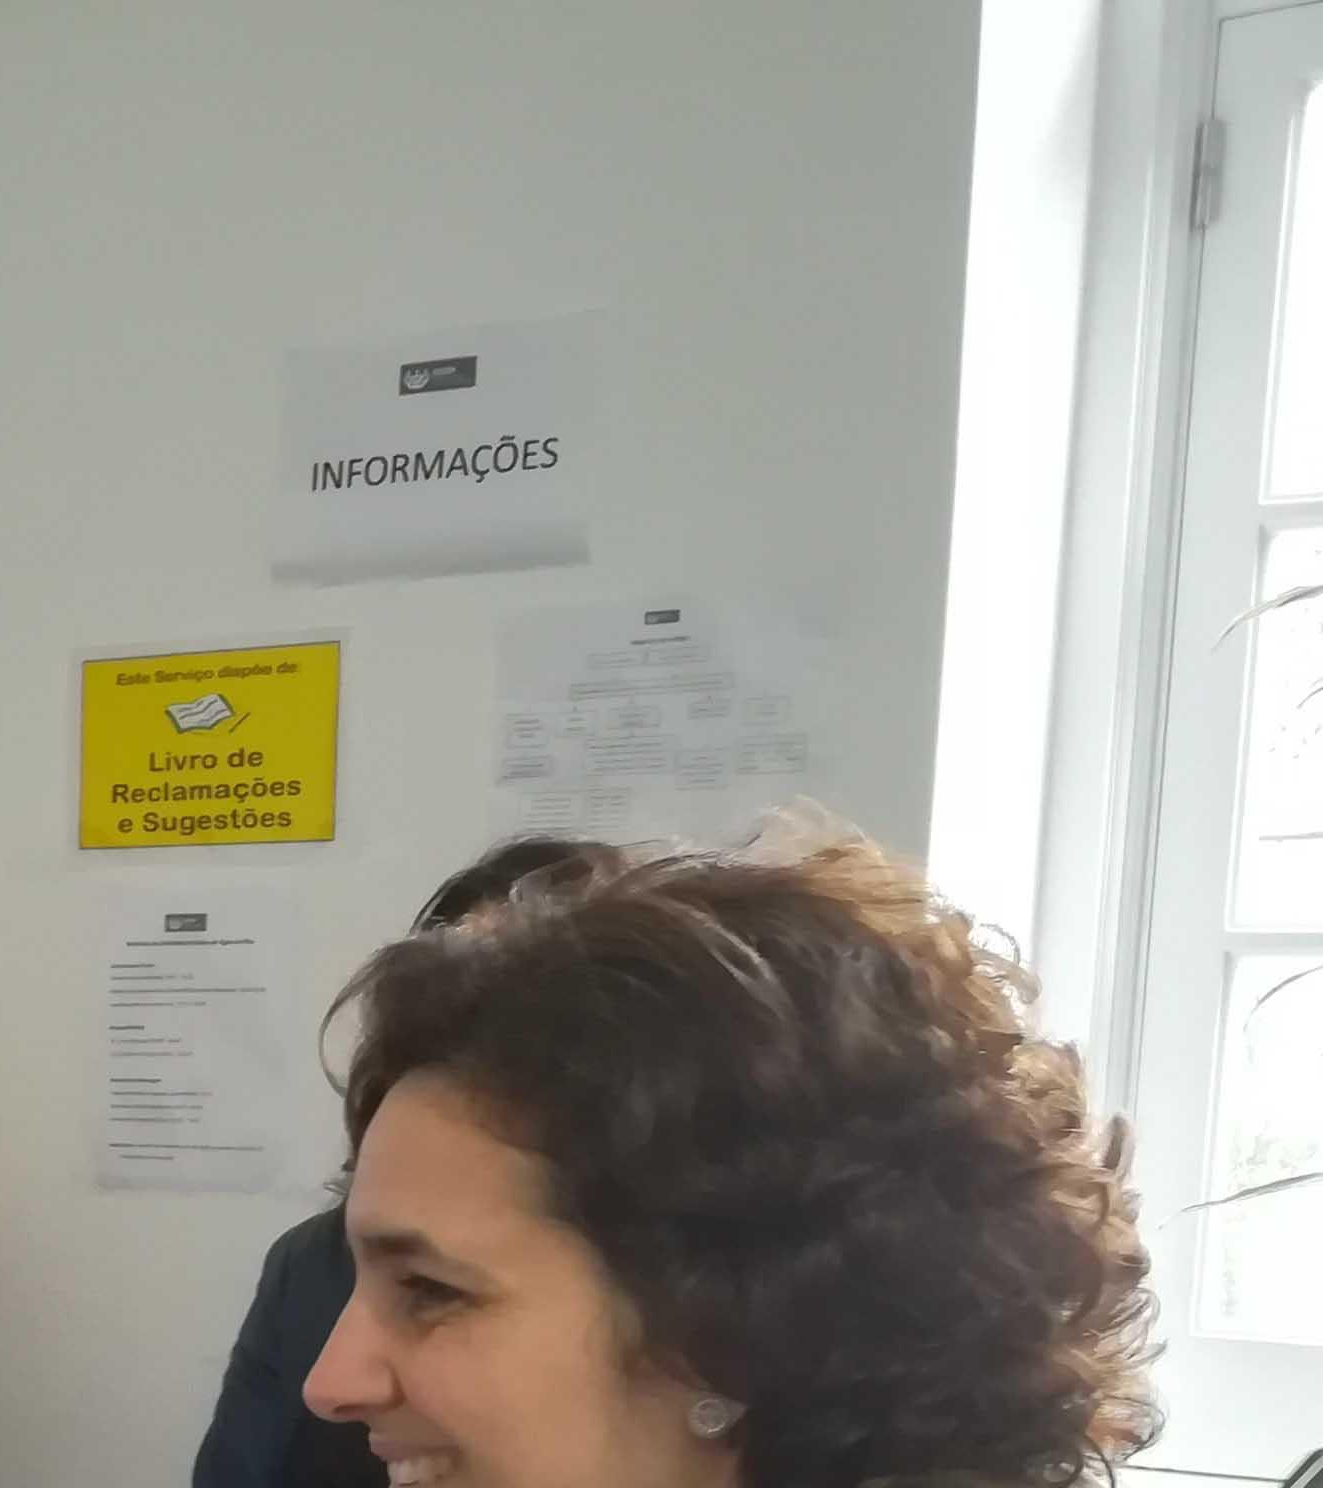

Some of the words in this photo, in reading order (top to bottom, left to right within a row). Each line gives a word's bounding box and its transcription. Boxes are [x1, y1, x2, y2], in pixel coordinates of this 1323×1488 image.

[311, 435, 559, 492] INFORMAÇÕES
[148, 751, 218, 773] Livro
[226, 747, 264, 769] de
[111, 777, 302, 804] Reclamações
[117, 818, 133, 833] e
[142, 808, 293, 836] Sugestões
